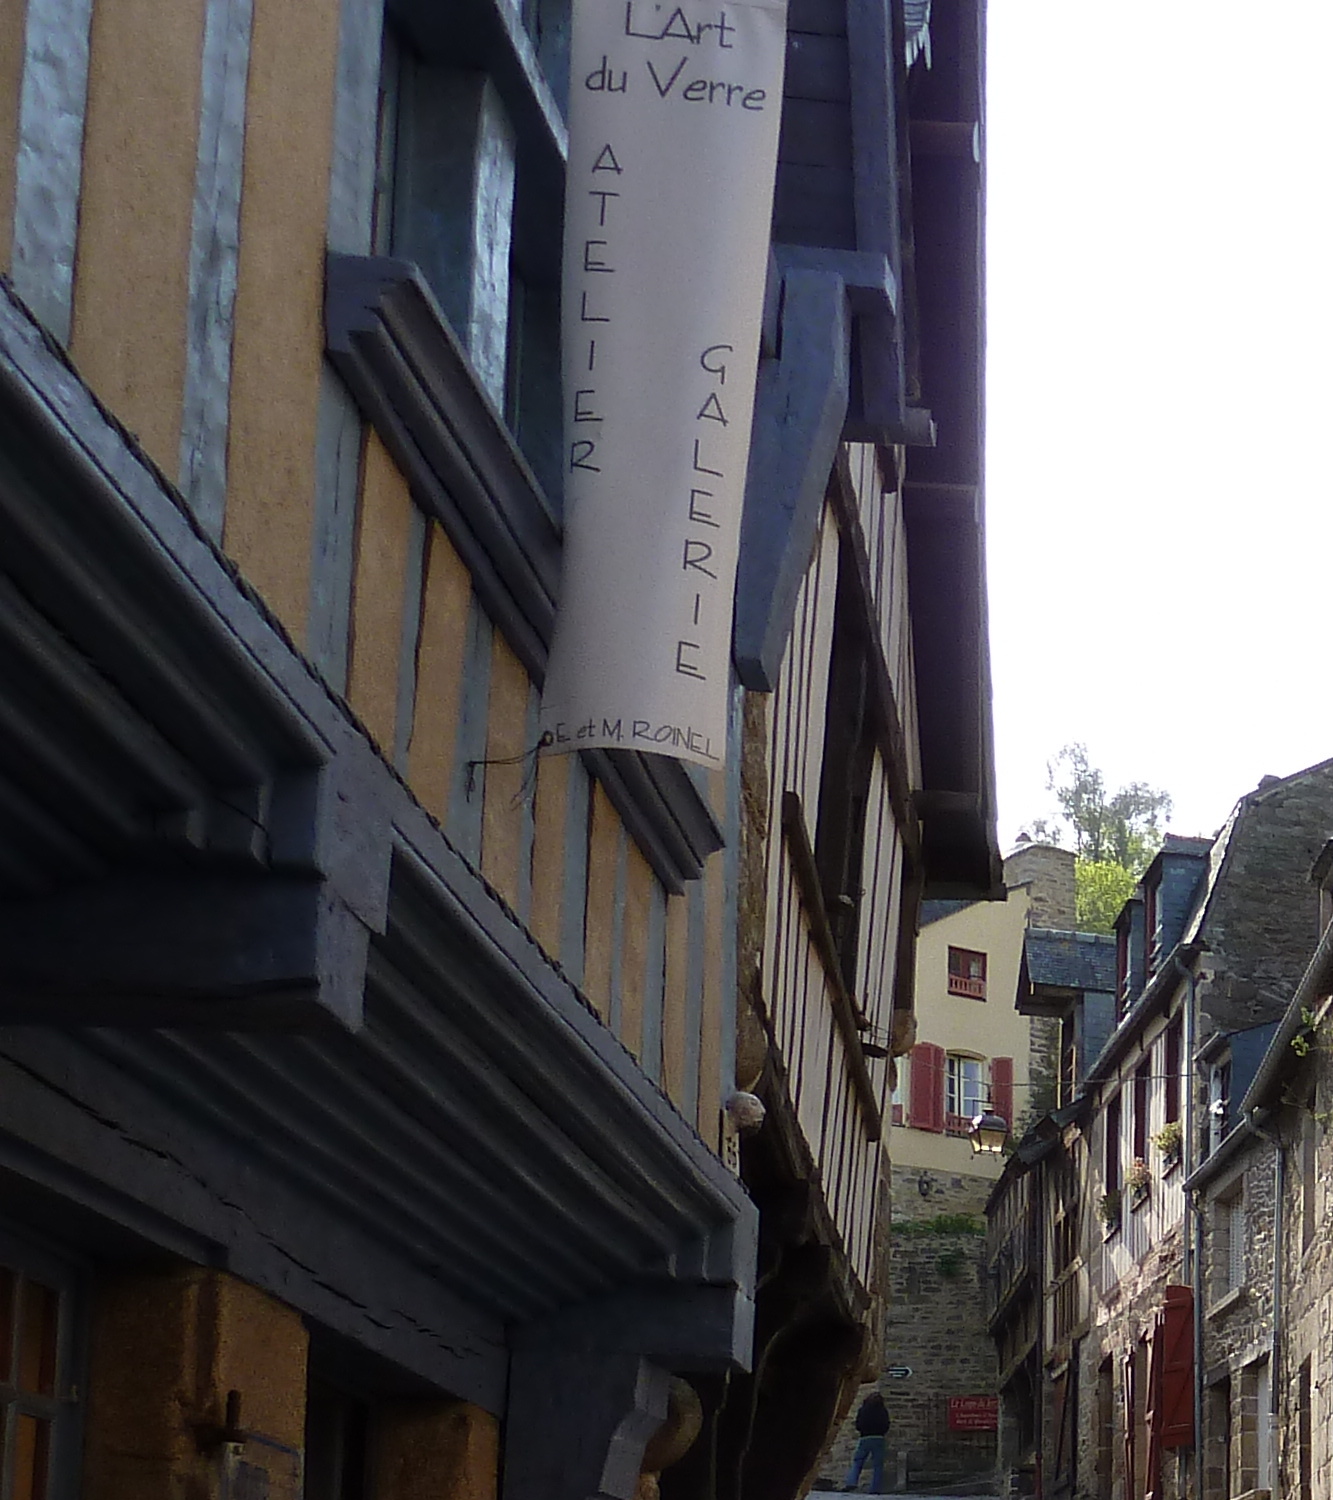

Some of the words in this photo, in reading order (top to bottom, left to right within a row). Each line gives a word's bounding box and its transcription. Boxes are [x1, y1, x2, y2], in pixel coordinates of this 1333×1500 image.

[625, 1, 736, 48] L'Art
[585, 55, 627, 93] du
[646, 56, 766, 110] Verre
[570, 143, 622, 473] ATELIER
[676, 345, 733, 680] GALERIE
[577, 718, 596, 739] et
